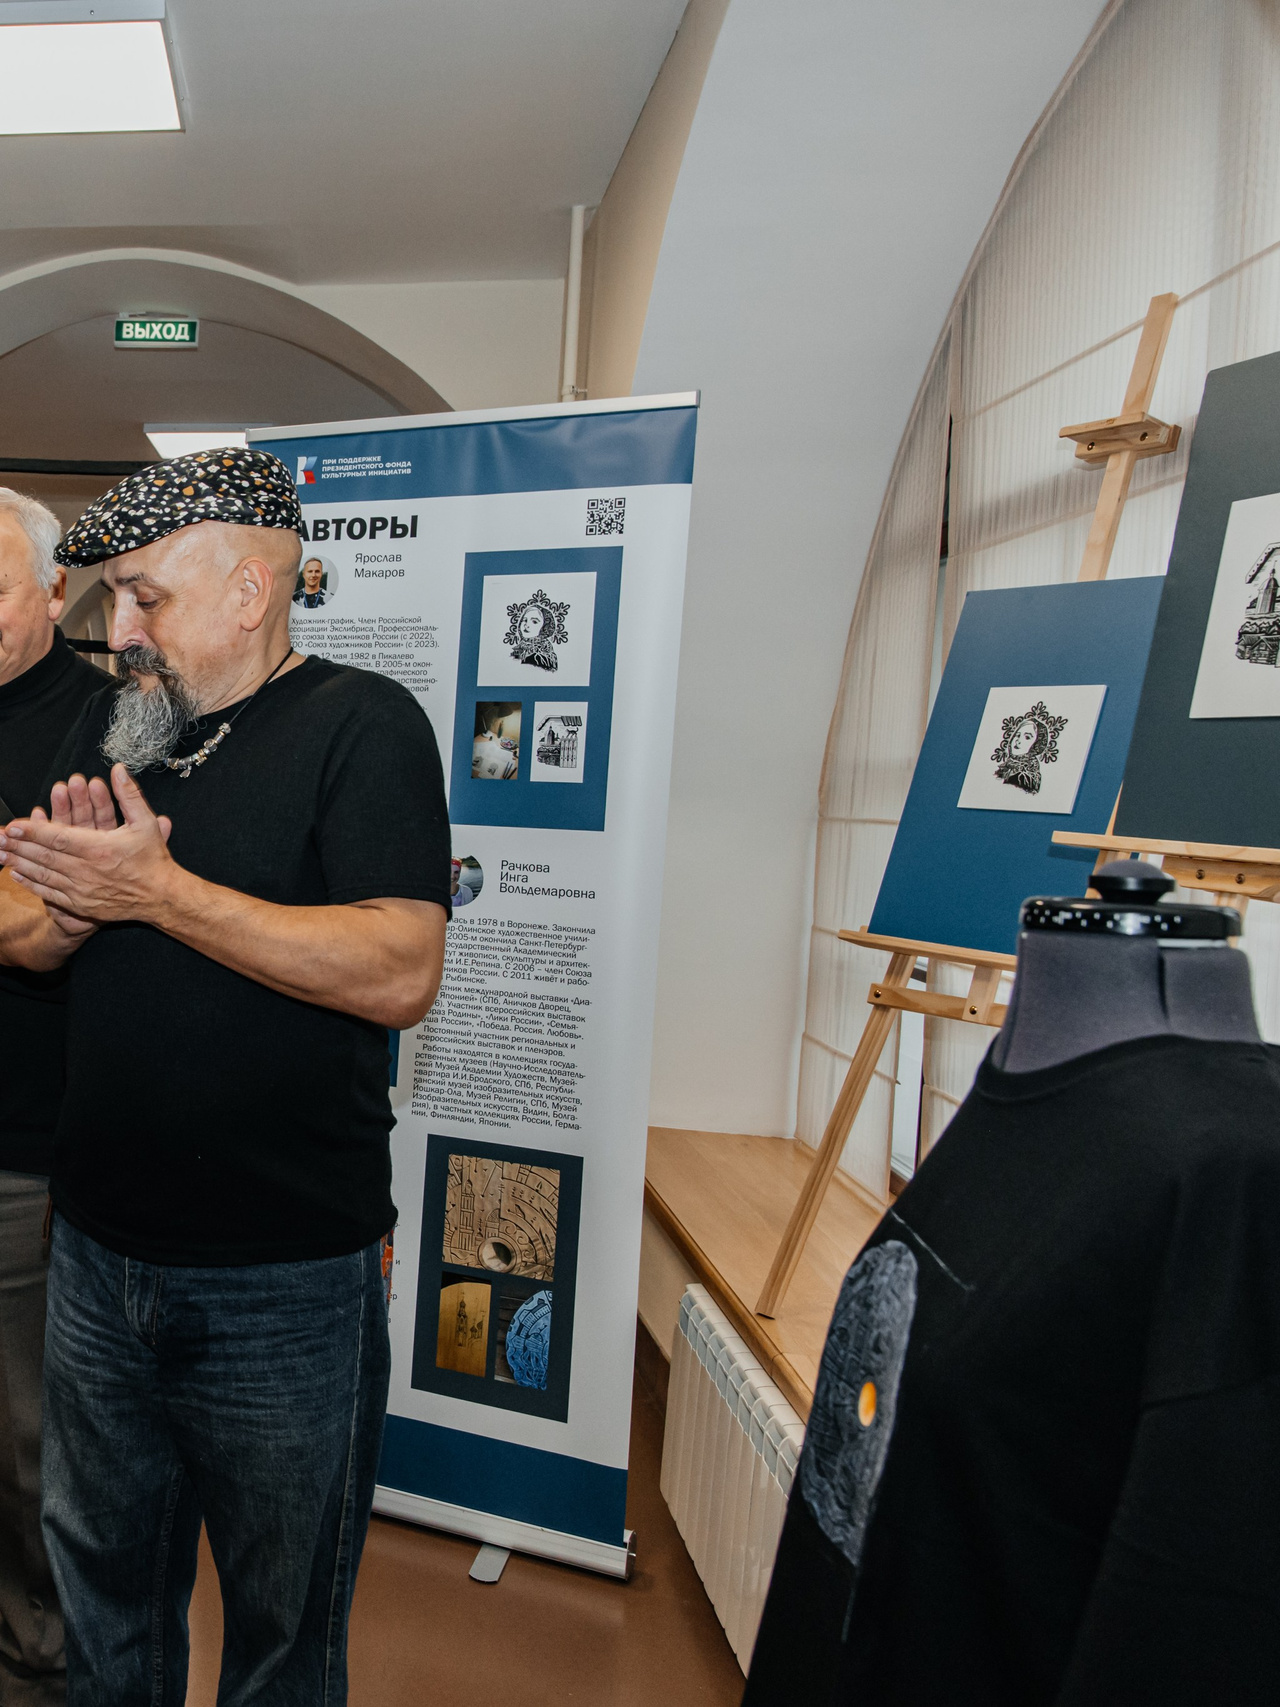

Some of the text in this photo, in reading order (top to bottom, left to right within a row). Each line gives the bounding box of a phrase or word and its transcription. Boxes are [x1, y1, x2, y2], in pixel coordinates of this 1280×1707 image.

[122, 323, 190, 341] ВЫХОД
[322, 463, 383, 471] ПРЕЗИДЕНТСКОГО
[300, 515, 418, 541] АВТОРЫ
[355, 553, 402, 564] Ярослав
[354, 568, 405, 579] Макаров
[378, 625, 438, 633] Профессиональ-
[501, 860, 550, 873] Рачкова
[500, 872, 528, 883] Инга
[500, 882, 596, 899] Вольдемаровна
[478, 919, 498, 927] 1978
[552, 925, 596, 935] Закончила
[498, 931, 562, 940] художественное
[446, 942, 577, 959] осударственный Академический
[447, 933, 587, 952] 2005-м окончила Санкт-Петербург-
[502, 956, 546, 966] скульптуры
[510, 972, 531, 981] 2011
[512, 964, 535, 972] 2006
[565, 969, 592, 978] Союза
[440, 992, 477, 1002] Японией»
[503, 999, 537, 1009] Аничков
[464, 988, 592, 1006] международной выставки «Диа-
[447, 1001, 586, 1022] Участник всероссийских выставок
[484, 1014, 508, 1023] «Лики
[547, 1021, 579, 1030] «Семья-
[416, 1035, 475, 1046] всероссийских
[478, 1042, 516, 1051] выставок
[424, 1026, 568, 1049] Постоянный участник региональных
[422, 1044, 578, 1069] Работы находятся коллекциях госуда-
[415, 1054, 586, 1078] рственных музеев (Научно-Исследователь-
[435, 1062, 460, 1072] Музей
[462, 1066, 502, 1077] Академии
[550, 1076, 578, 1086] Музей-
[413, 1070, 575, 1094] квартира Республи-
[413, 1078, 446, 1087] канский
[473, 1086, 545, 1100] изобразительных
[413, 1092, 481, 1108] Изобразительных
[553, 1111, 578, 1121] Болга-
[466, 1091, 491, 1101] Музей
[552, 1102, 578, 1112] Музей
[440, 1106, 472, 1115] частных
[474, 1111, 519, 1122] коллекциях
[555, 1120, 582, 1130] Герма-
